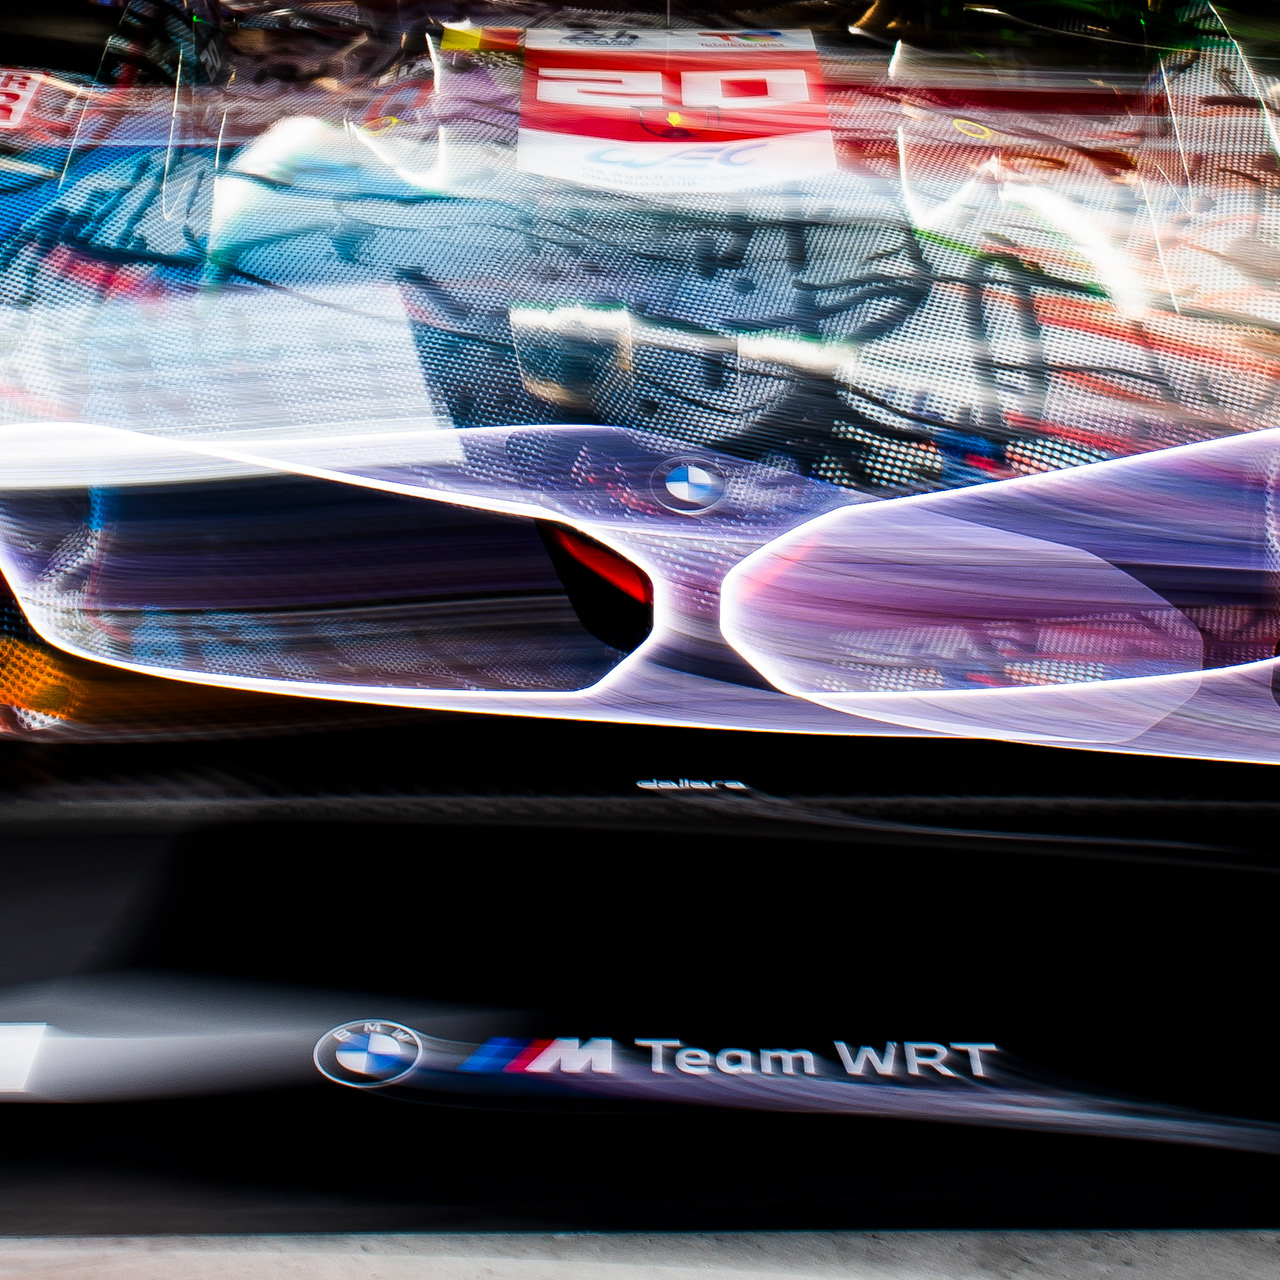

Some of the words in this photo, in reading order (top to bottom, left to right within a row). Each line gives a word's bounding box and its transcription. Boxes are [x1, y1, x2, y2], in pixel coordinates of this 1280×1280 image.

[537, 67, 810, 108] 20
[524, 1036, 613, 1072] M
[634, 1037, 815, 1076] Team
[833, 1041, 998, 1078] WRT
